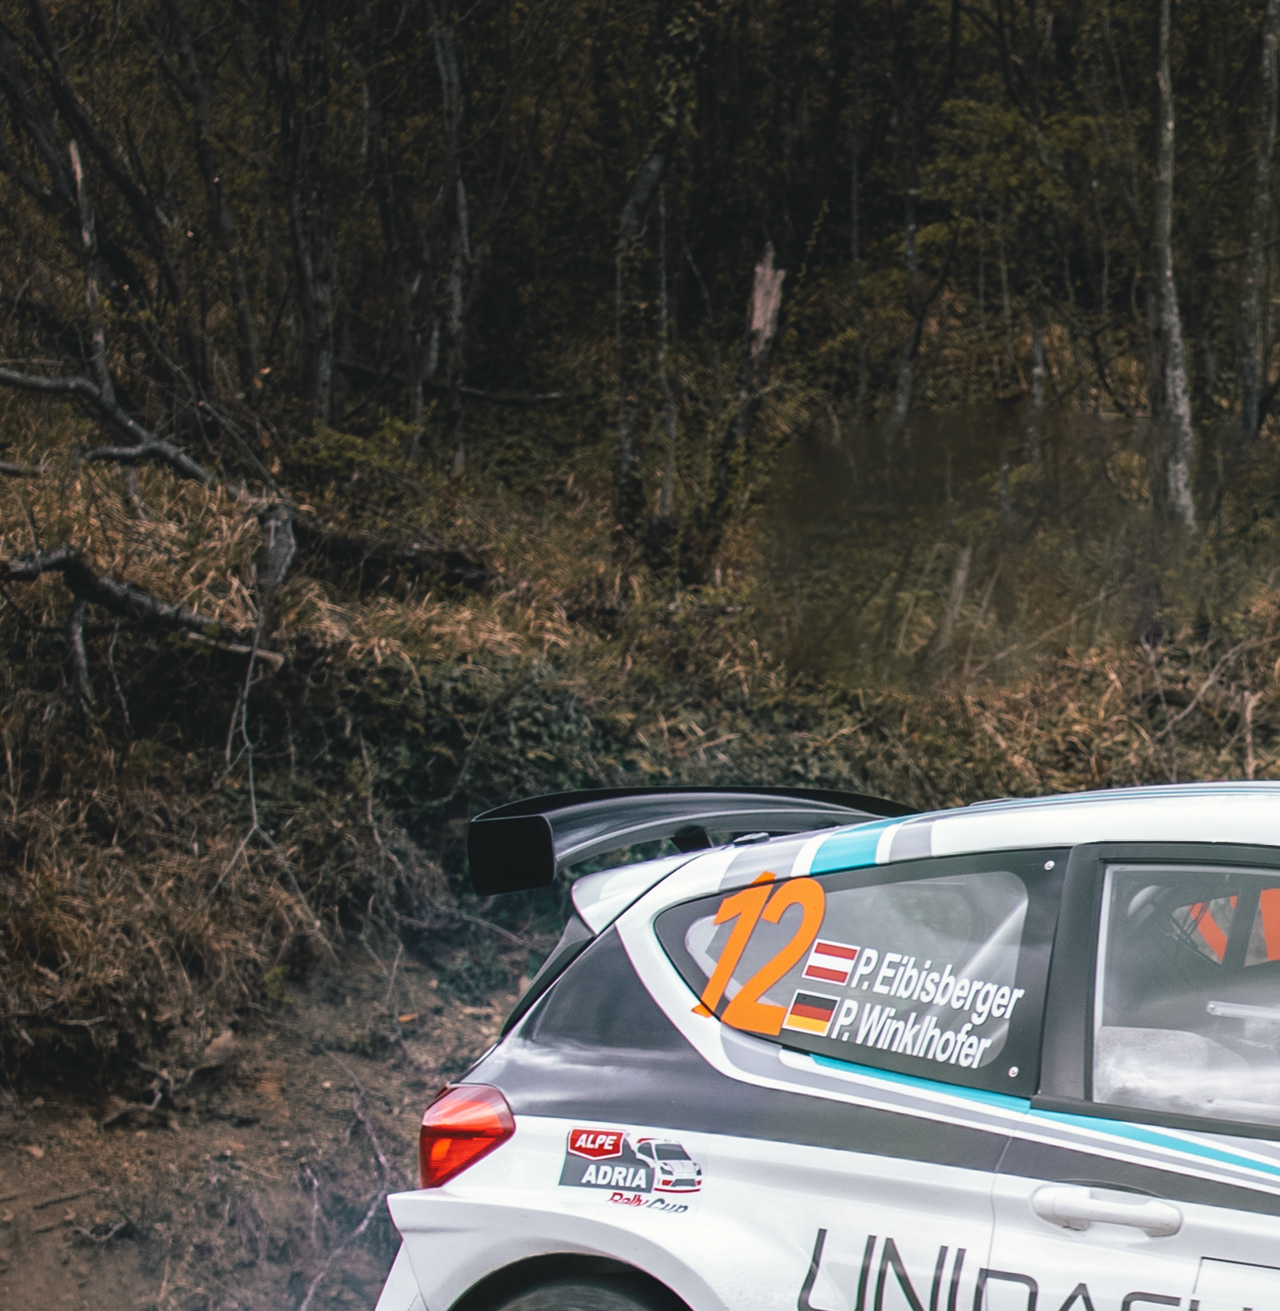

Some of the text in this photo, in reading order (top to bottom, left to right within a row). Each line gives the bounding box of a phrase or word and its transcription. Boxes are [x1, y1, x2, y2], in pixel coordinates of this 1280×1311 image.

[691, 871, 827, 1036] 12
[850, 947, 1025, 1025] P. Eibisberger
[830, 998, 993, 1070] P. Winklhofer
[574, 1133, 618, 1151] ALPE
[580, 1164, 647, 1189] ADRIA
[607, 1191, 689, 1214] Rally Cup
